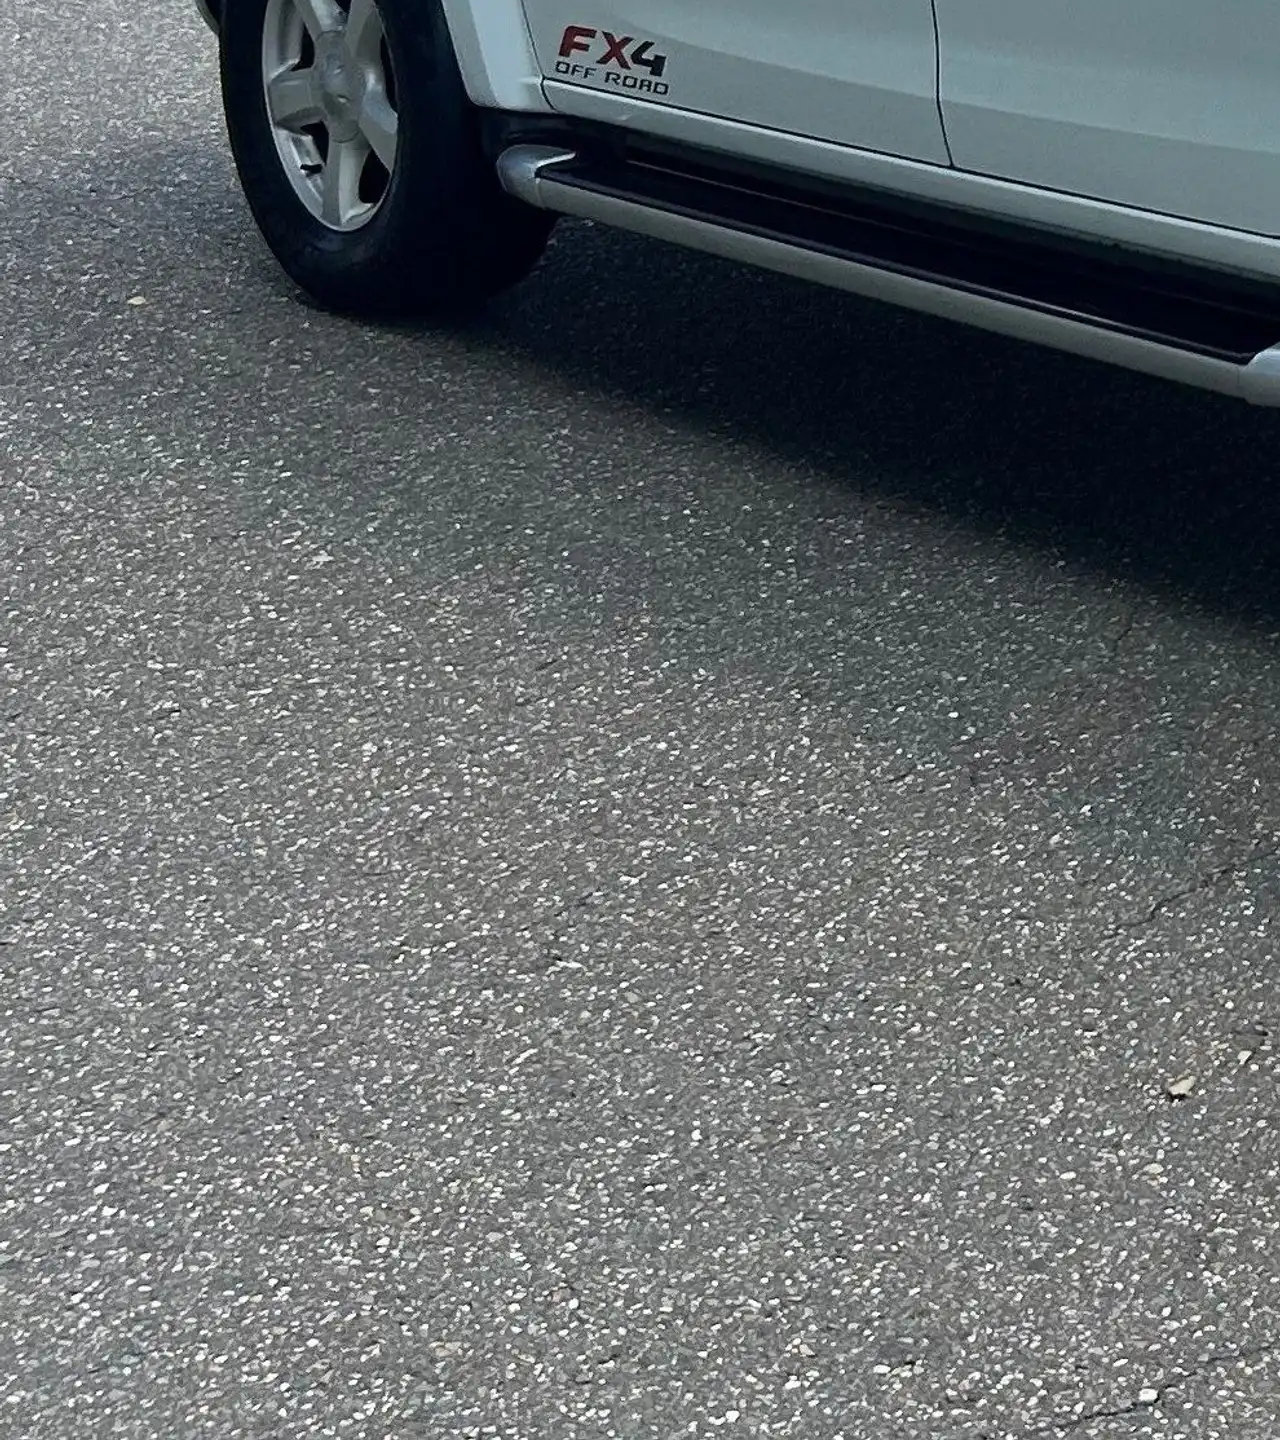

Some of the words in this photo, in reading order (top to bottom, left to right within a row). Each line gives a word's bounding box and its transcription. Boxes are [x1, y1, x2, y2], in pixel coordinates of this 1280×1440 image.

[557, 24, 668, 77] FX4
[555, 60, 597, 80] OFF
[604, 70, 670, 96] ROAD
